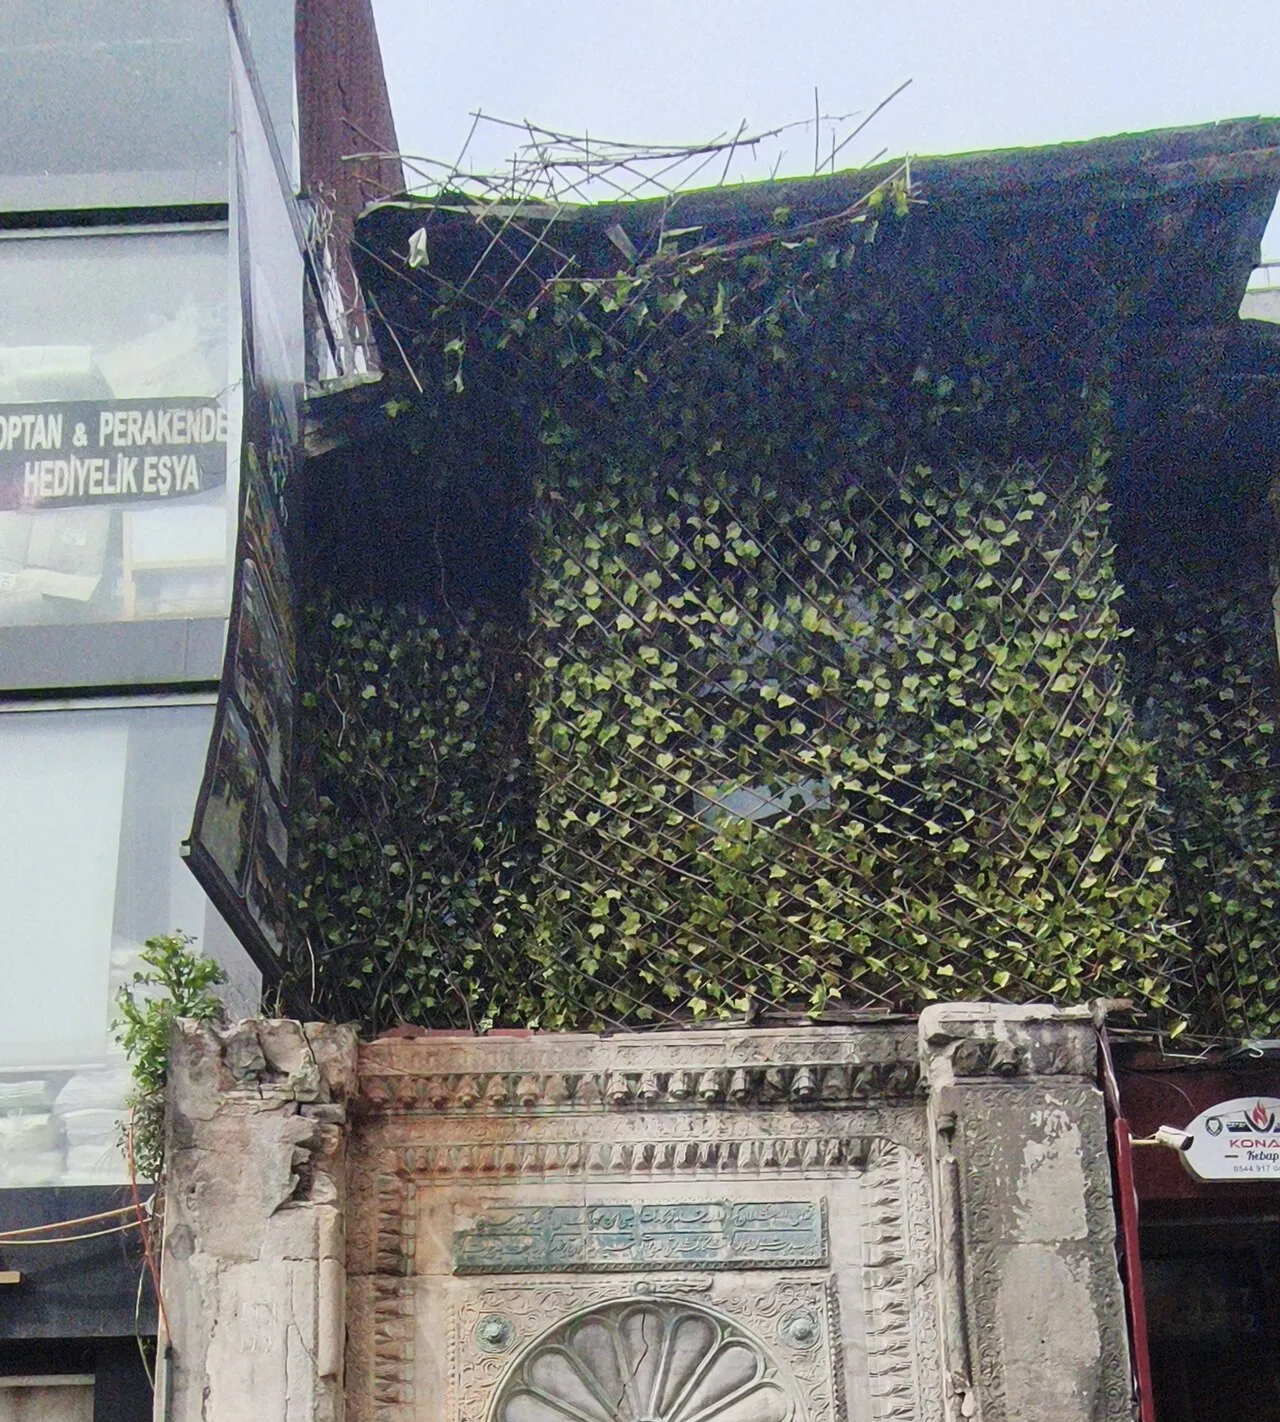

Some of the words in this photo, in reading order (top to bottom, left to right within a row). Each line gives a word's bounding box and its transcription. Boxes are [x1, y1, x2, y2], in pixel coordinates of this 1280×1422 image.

[72, 422, 88, 447] &
[99, 407, 228, 446] PERAKENDE
[24, 452, 137, 497] HEDİYELİK
[143, 454, 200, 496] EŞYA
[1246, 1150, 1280, 1163] Kebap
